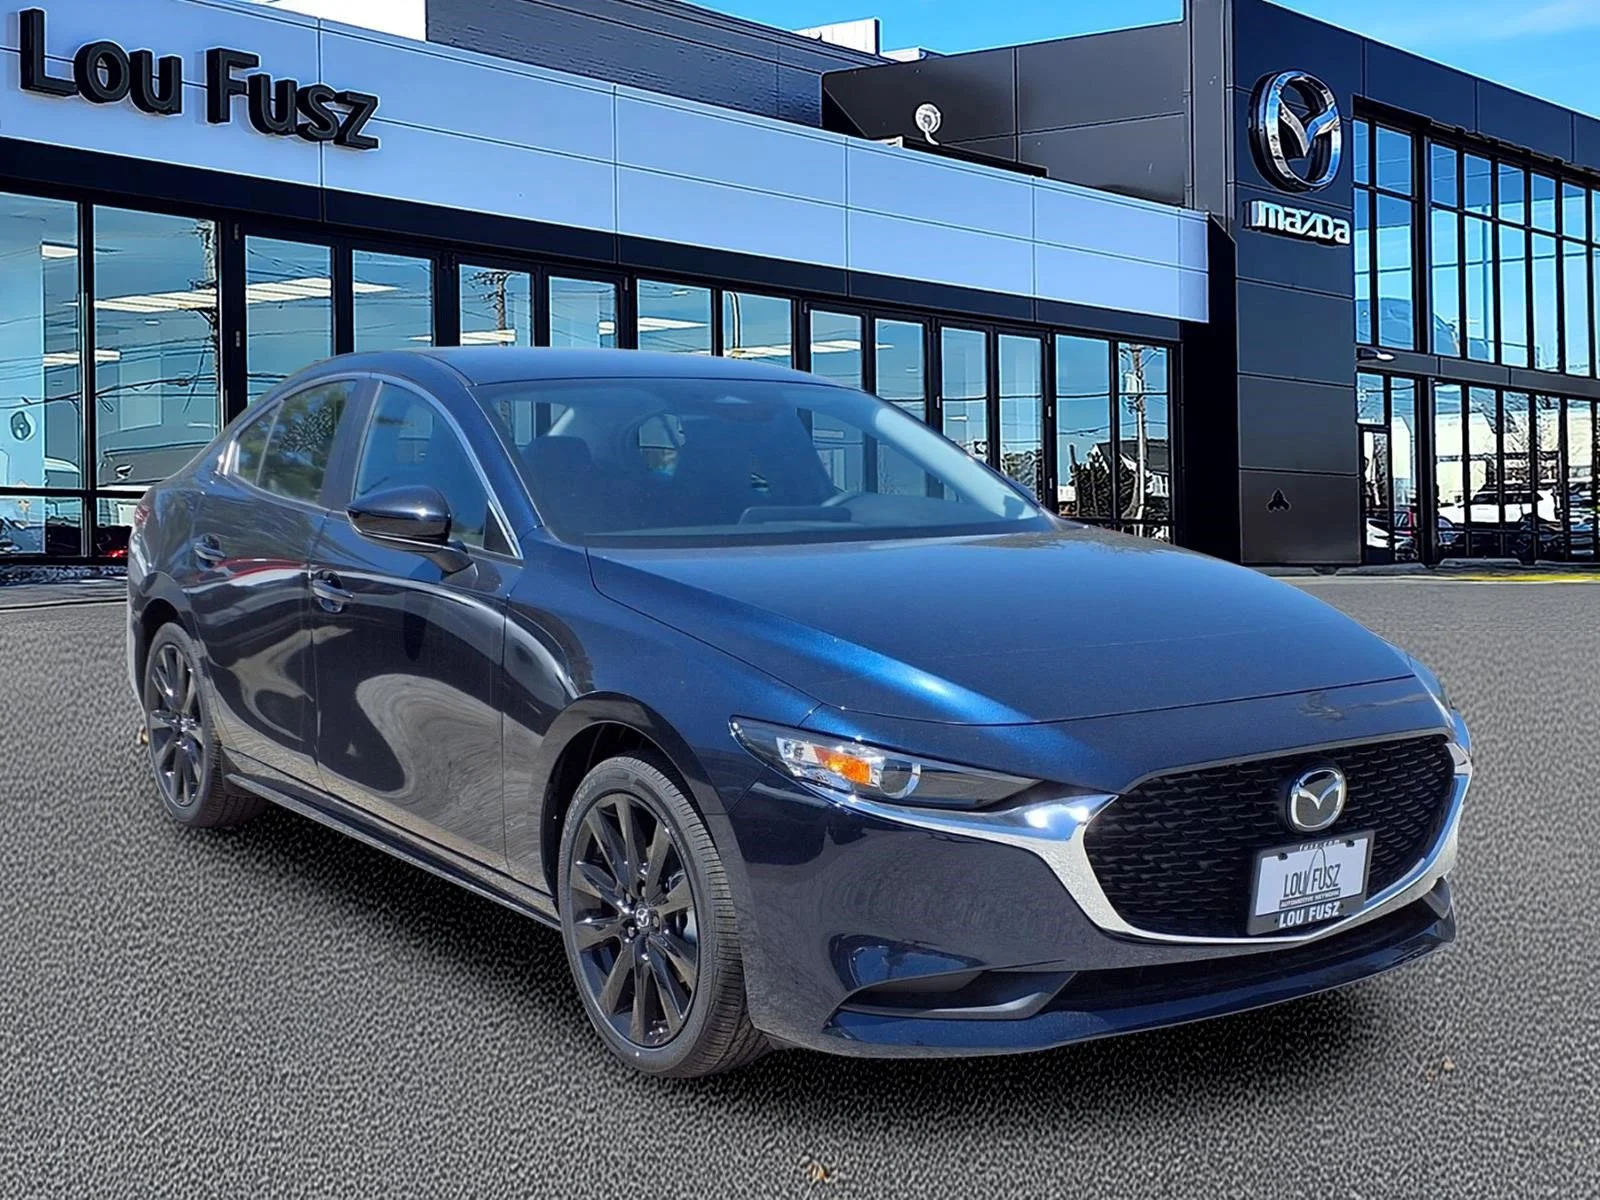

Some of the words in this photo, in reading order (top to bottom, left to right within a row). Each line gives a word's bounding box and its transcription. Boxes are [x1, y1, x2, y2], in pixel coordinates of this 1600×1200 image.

[20, 8, 182, 116] Lou
[206, 48, 380, 151] Fusz
[1283, 870, 1308, 898] LOU
[1310, 863, 1341, 892] FUSZ
[1279, 909, 1304, 928] LOU
[1308, 901, 1340, 921] FUSZ
